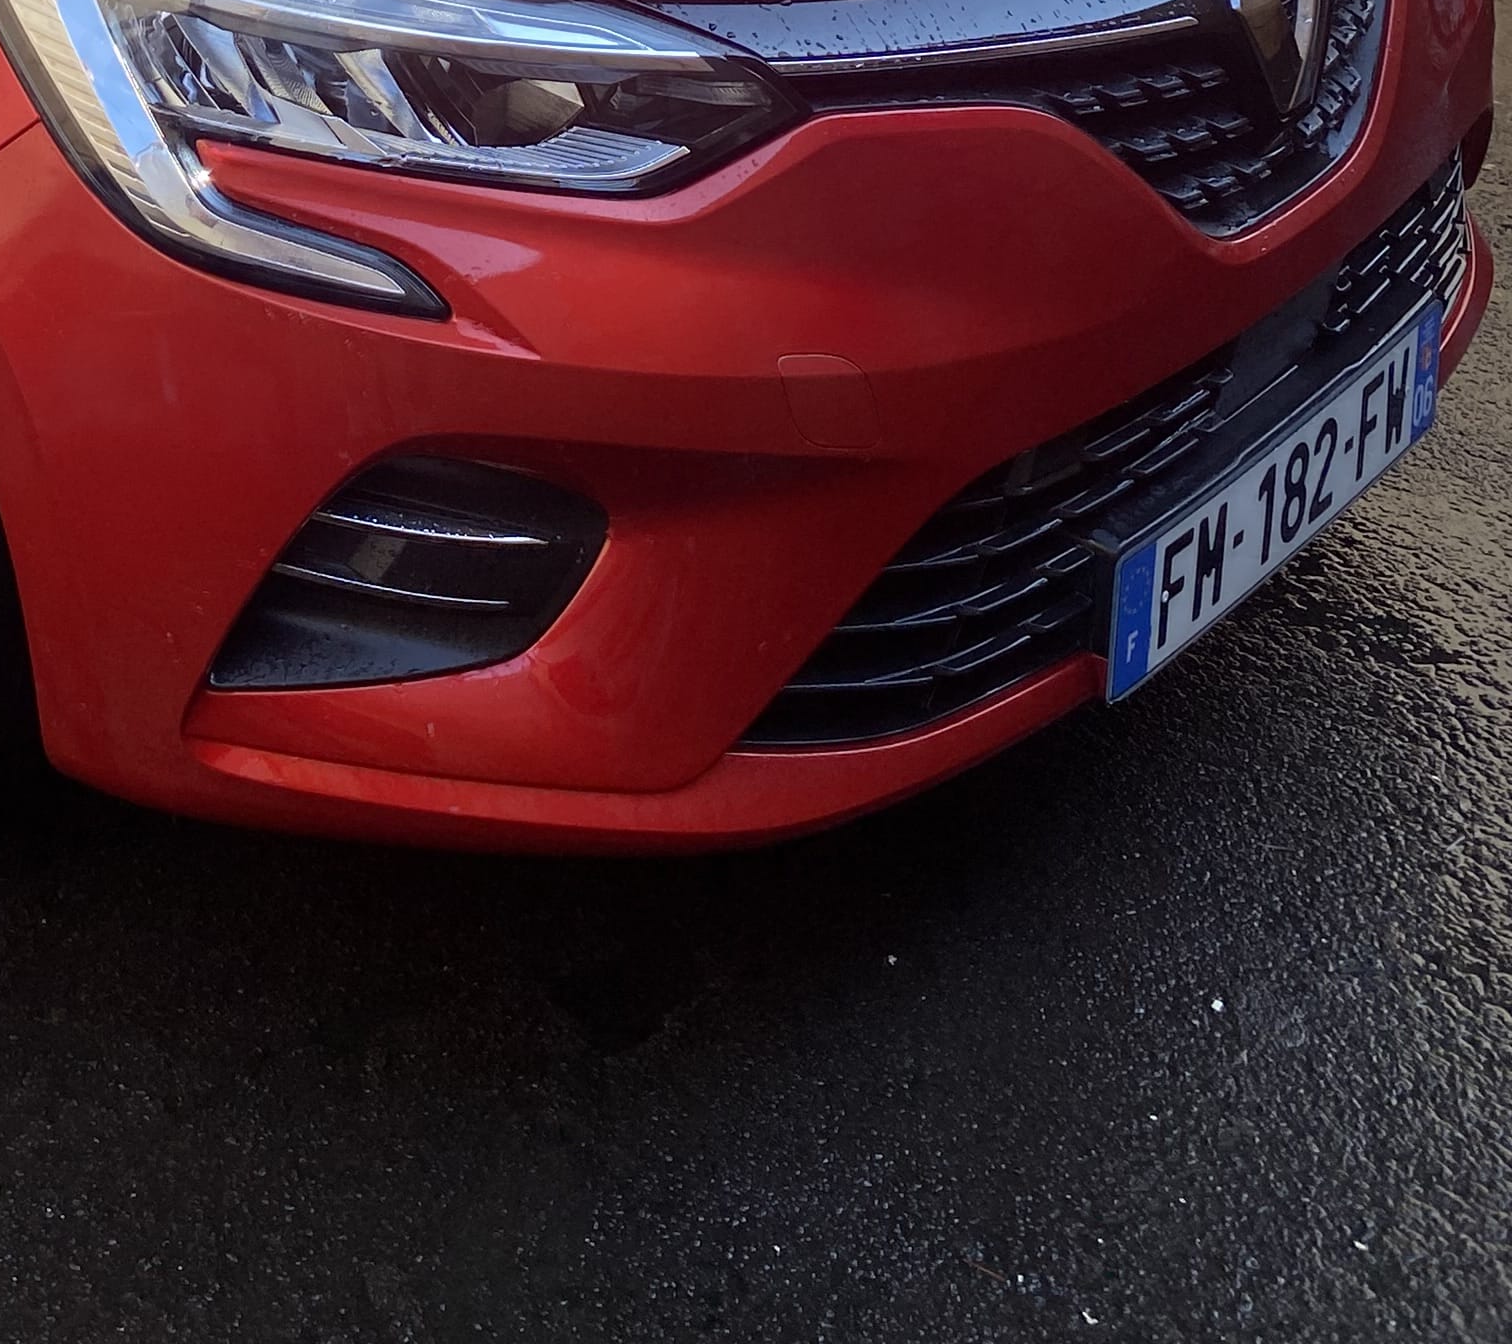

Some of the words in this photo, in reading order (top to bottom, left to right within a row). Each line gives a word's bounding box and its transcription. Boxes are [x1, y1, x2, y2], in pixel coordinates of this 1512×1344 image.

[1413, 374, 1434, 427] 06
[1156, 347, 1410, 650] FM-182-FW
[1126, 632, 1138, 664] F
